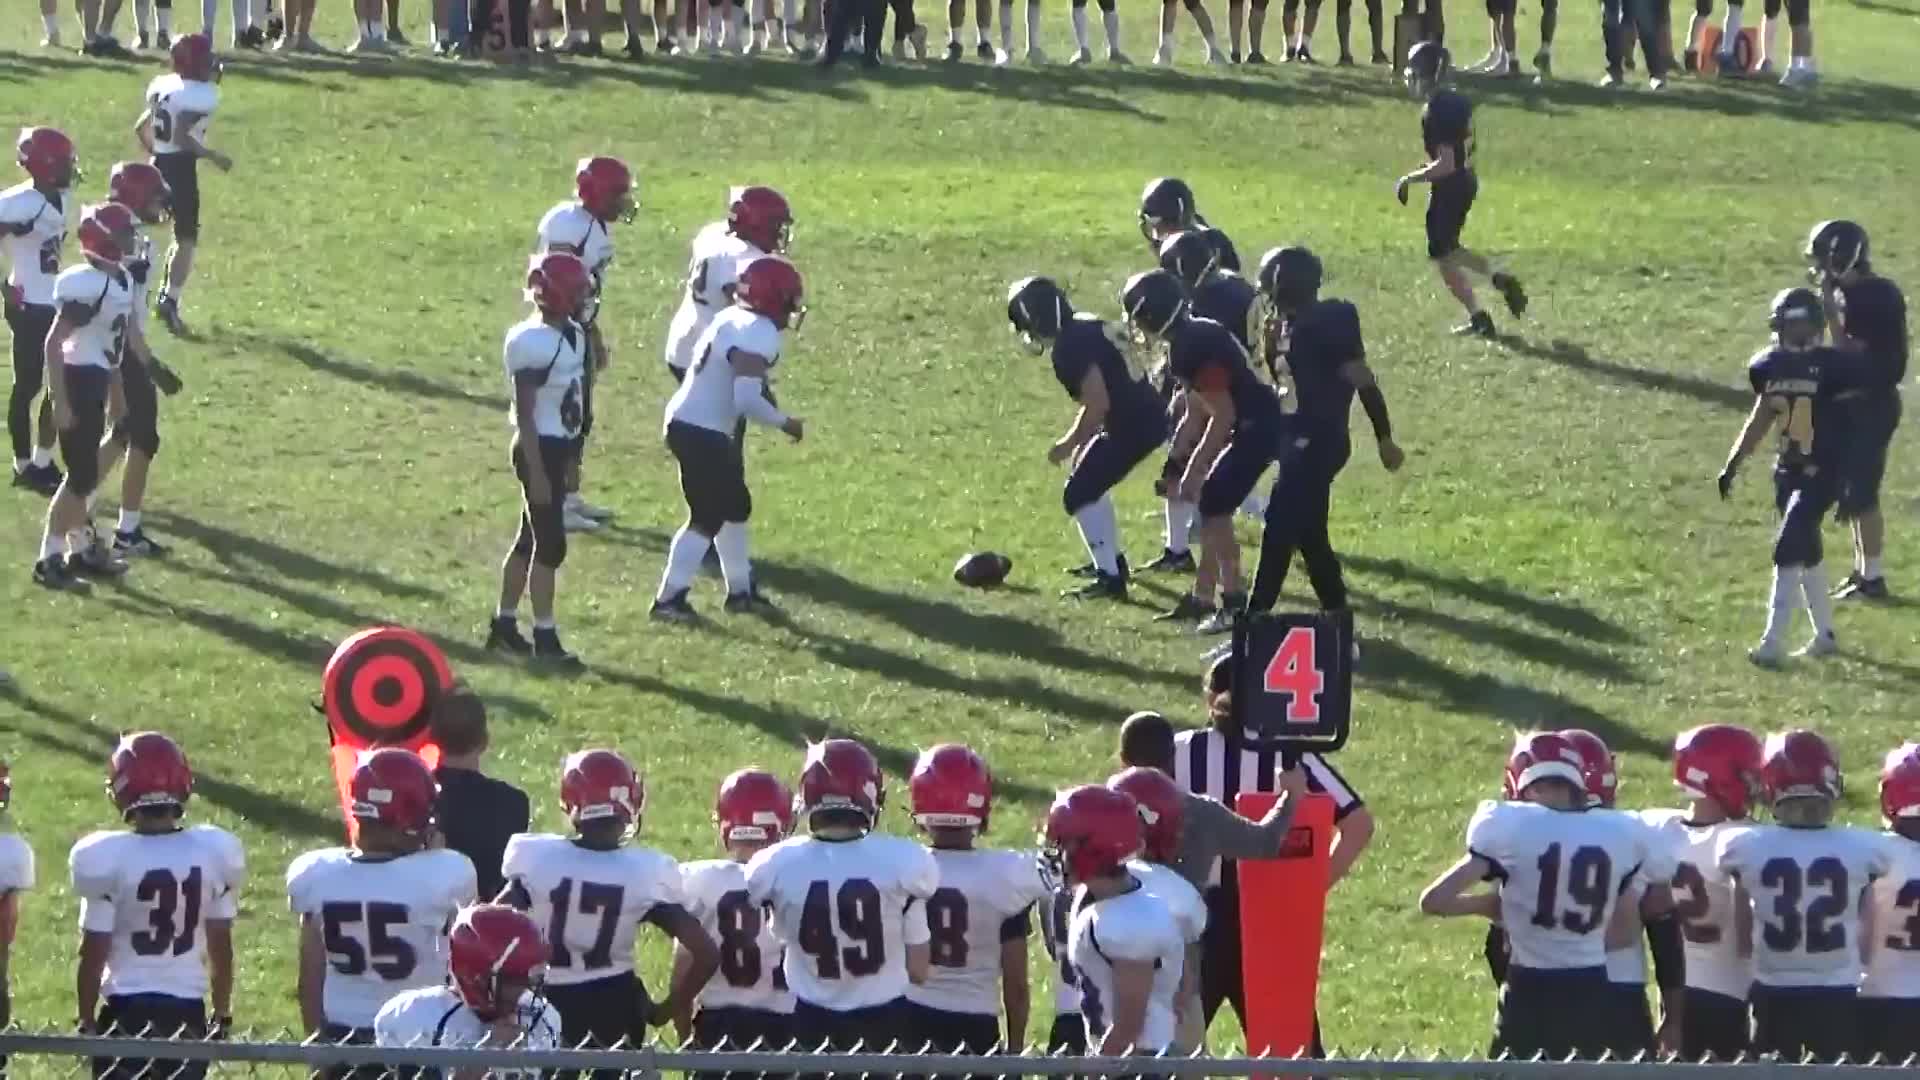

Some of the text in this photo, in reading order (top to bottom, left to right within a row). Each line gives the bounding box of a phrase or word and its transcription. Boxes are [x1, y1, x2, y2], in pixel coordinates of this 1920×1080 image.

[1264, 627, 1324, 723] 4
[131, 866, 200, 957] 31
[549, 878, 625, 969] 17
[799, 878, 885, 979] 49
[1531, 841, 1612, 935] 19
[1761, 856, 1848, 954] 32
[322, 901, 416, 981] 55
